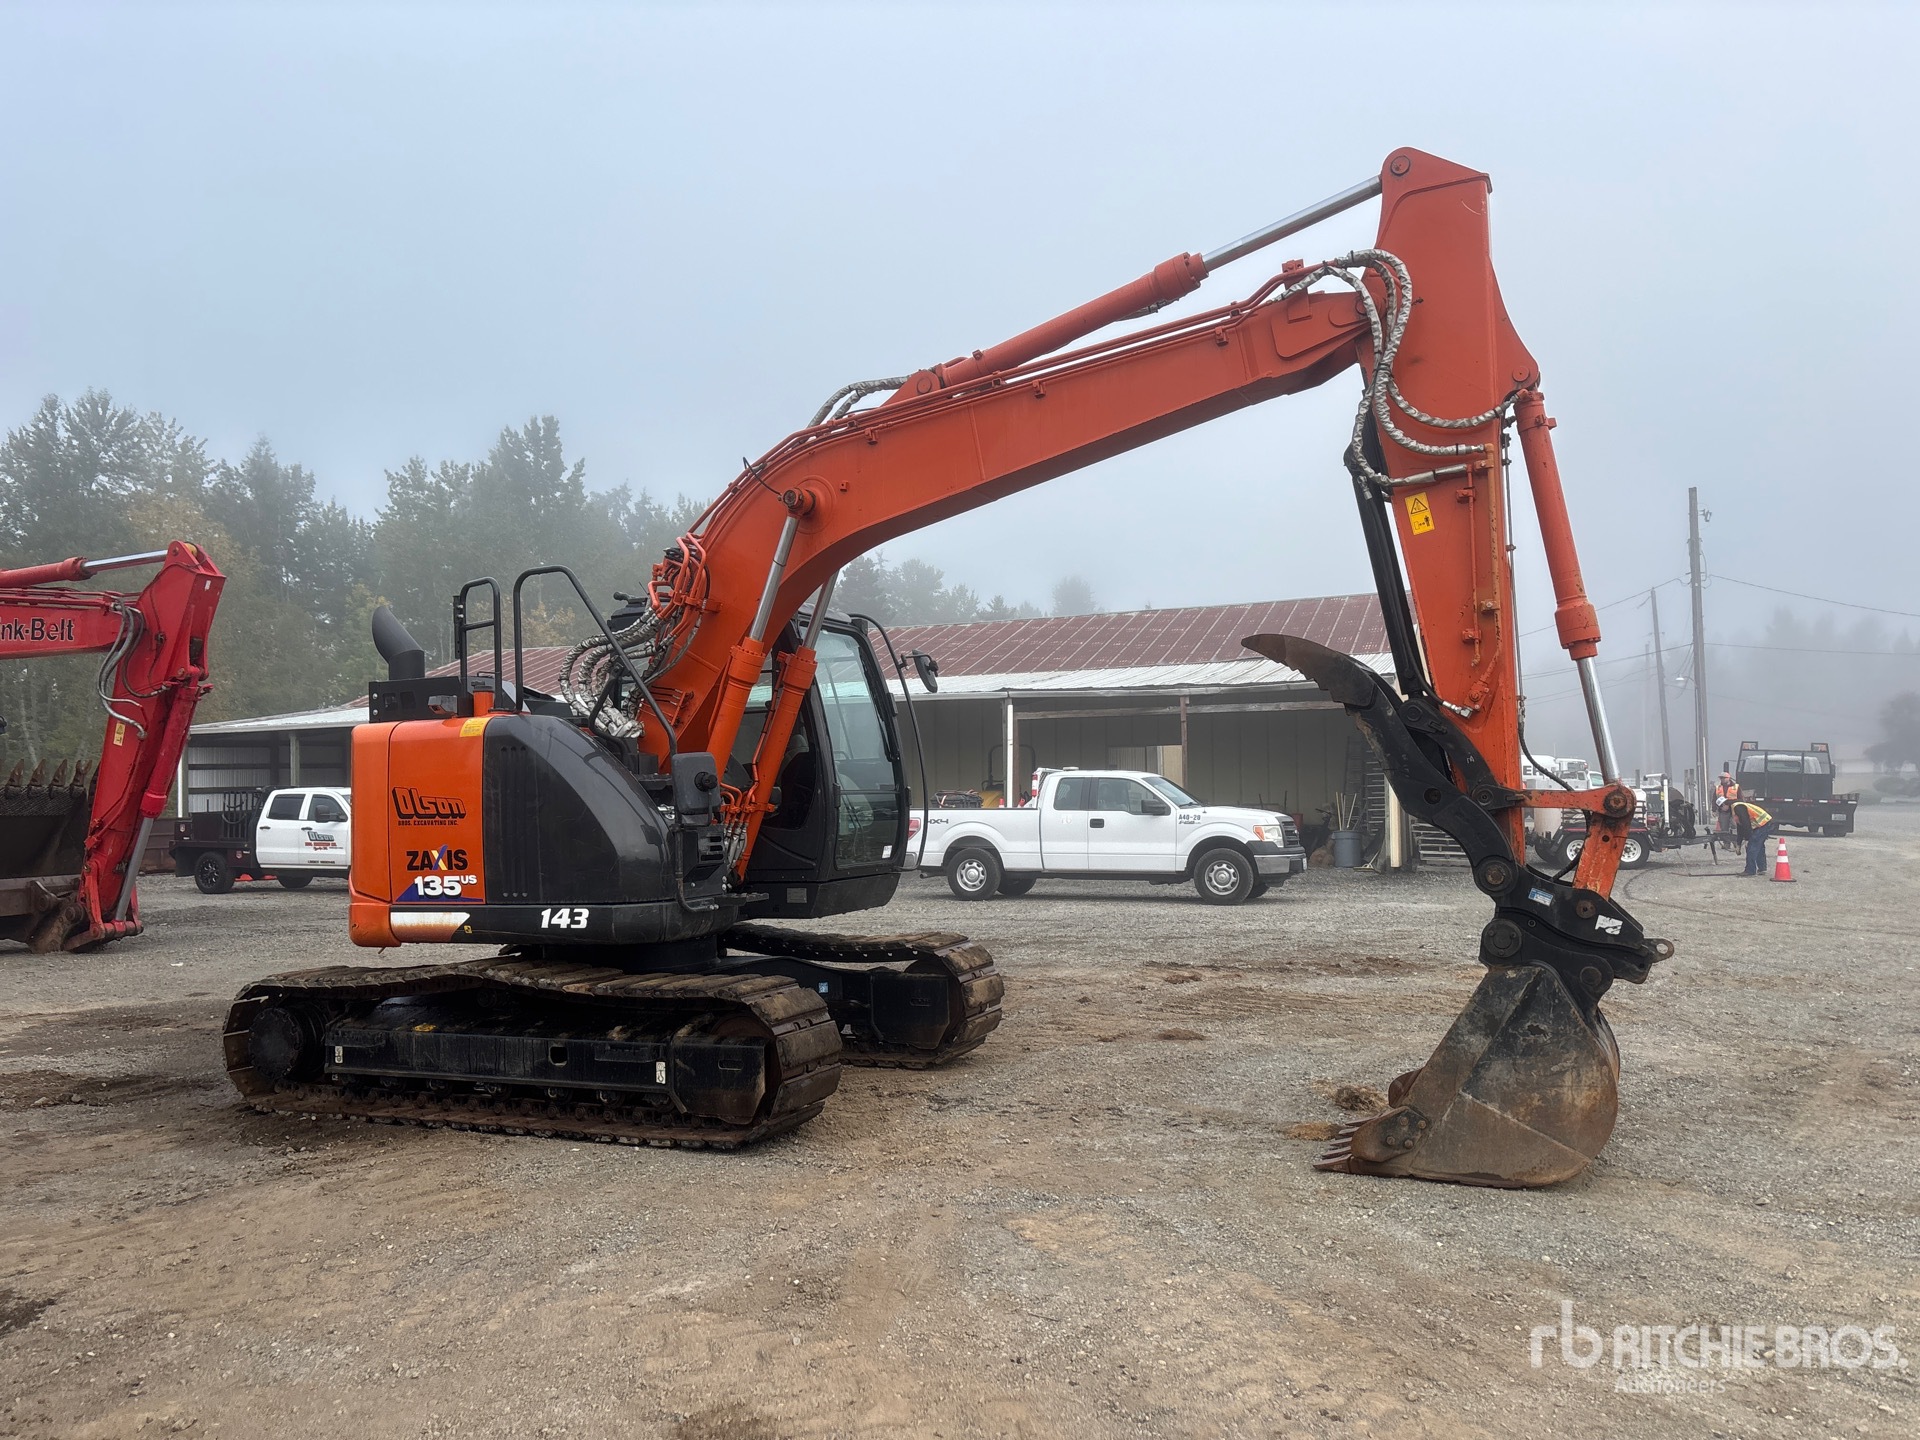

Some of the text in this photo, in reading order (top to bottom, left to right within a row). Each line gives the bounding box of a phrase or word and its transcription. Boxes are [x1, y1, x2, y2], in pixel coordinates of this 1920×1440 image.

[0, 617, 75, 641] nk-Belt
[391, 786, 467, 819] Olson
[406, 844, 468, 871] ZAXIS
[541, 907, 590, 929] 143
